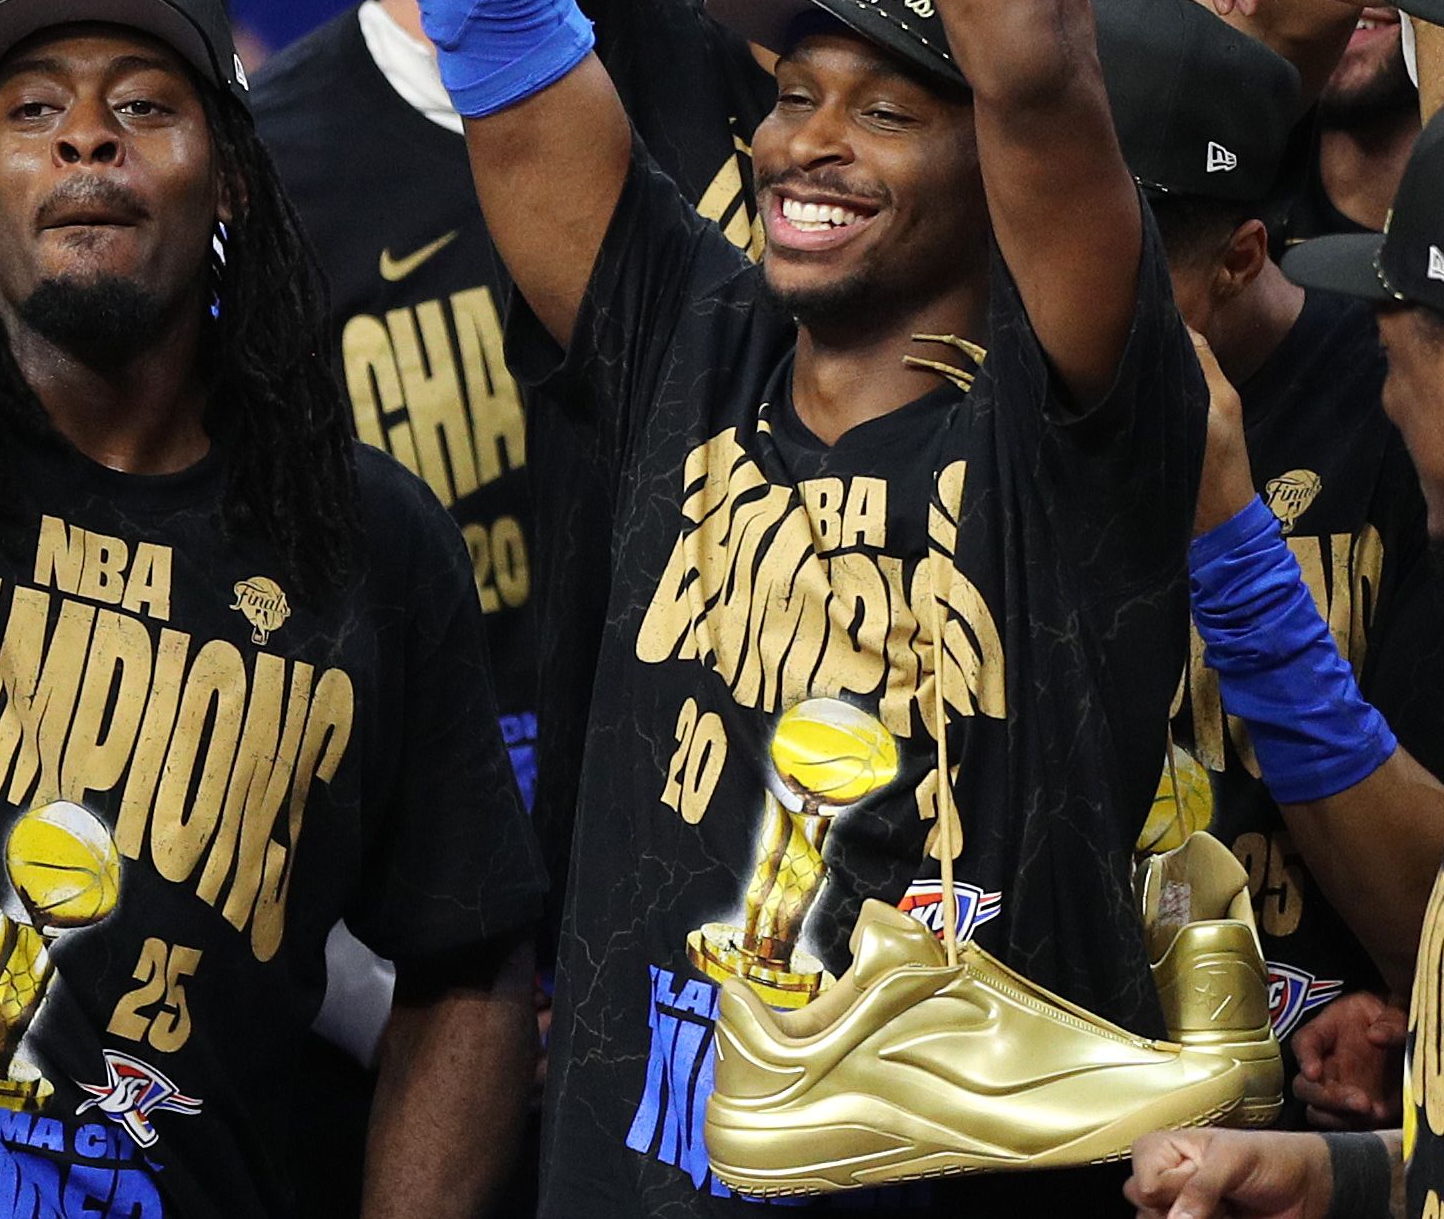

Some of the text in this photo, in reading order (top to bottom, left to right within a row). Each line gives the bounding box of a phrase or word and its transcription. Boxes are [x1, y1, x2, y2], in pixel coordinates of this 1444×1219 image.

[33, 514, 173, 621] NBA
[466, 516, 529, 614] 20
[799, 475, 888, 554] BA
[661, 697, 728, 825] 20
[106, 937, 203, 1053] 25
